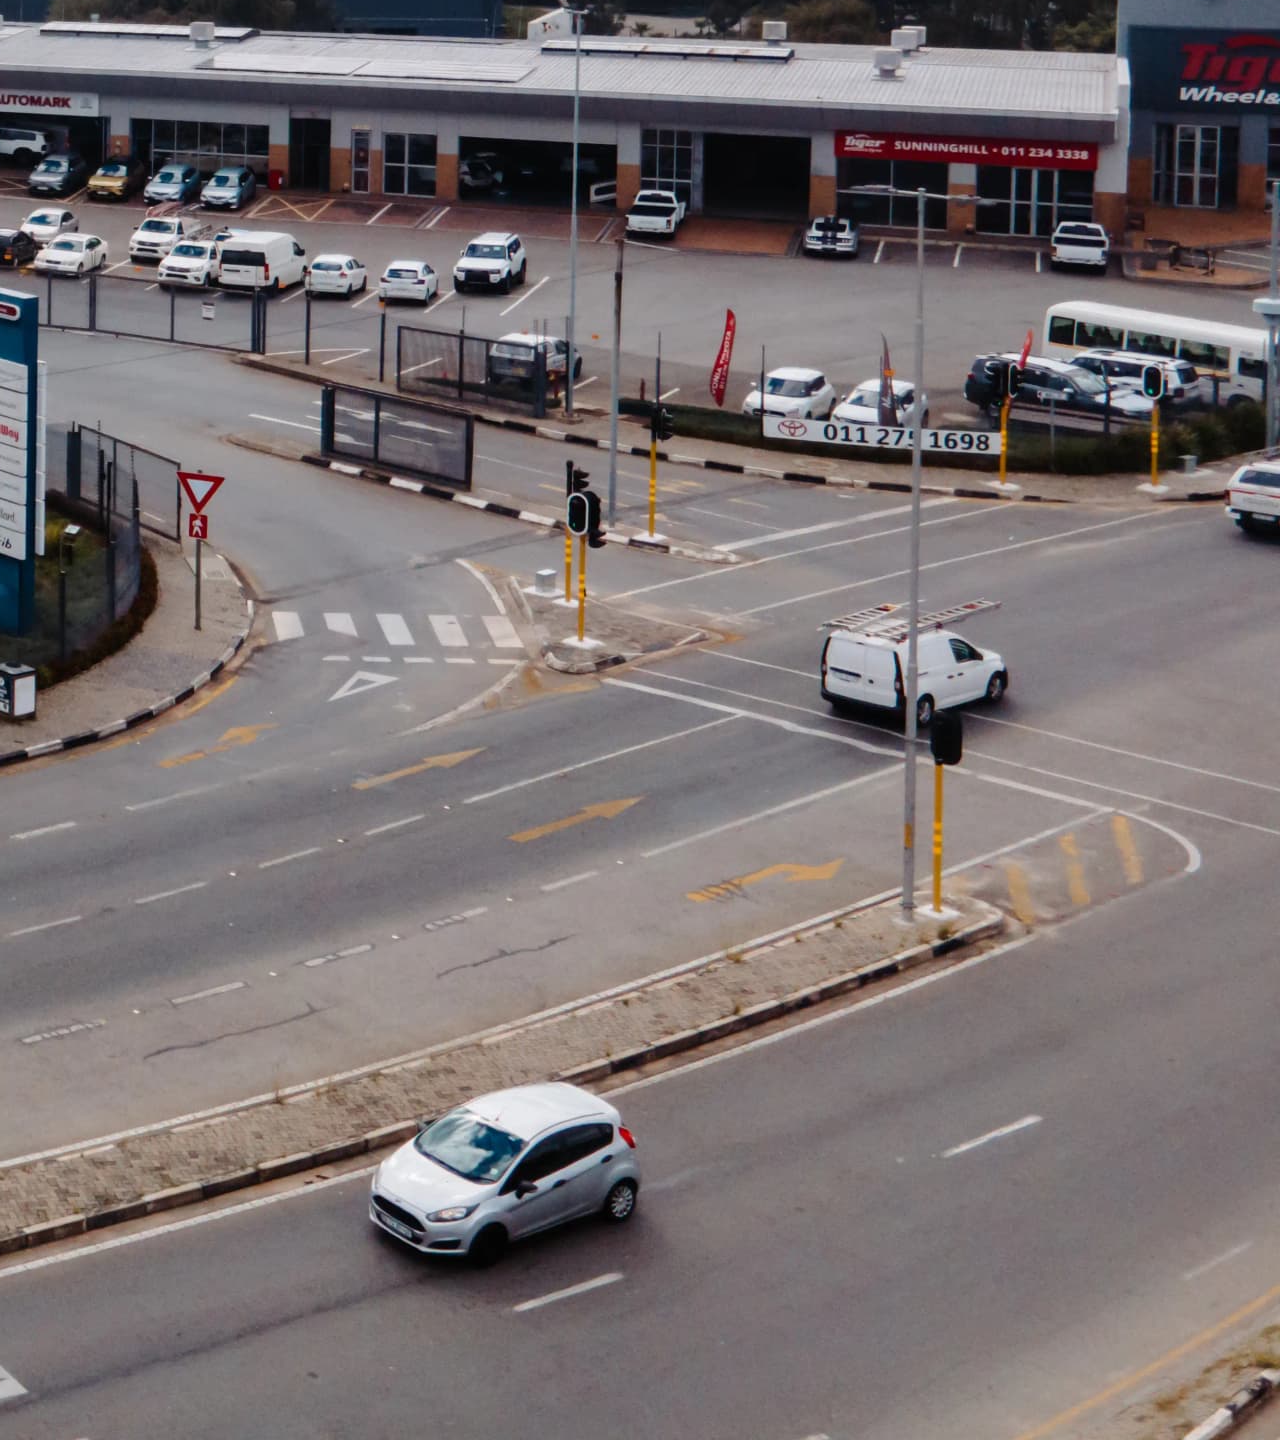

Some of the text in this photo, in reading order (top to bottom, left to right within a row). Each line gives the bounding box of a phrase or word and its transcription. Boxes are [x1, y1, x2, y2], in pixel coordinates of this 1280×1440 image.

[844, 135, 886, 148] Tiger
[893, 140, 989, 155] SUNNINGHILL
[1001, 147, 1025, 157] 011
[1028, 147, 1053, 159] 234
[1056, 149, 1089, 161] 3338
[823, 423, 869, 444] 011
[929, 431, 990, 452] 1698
